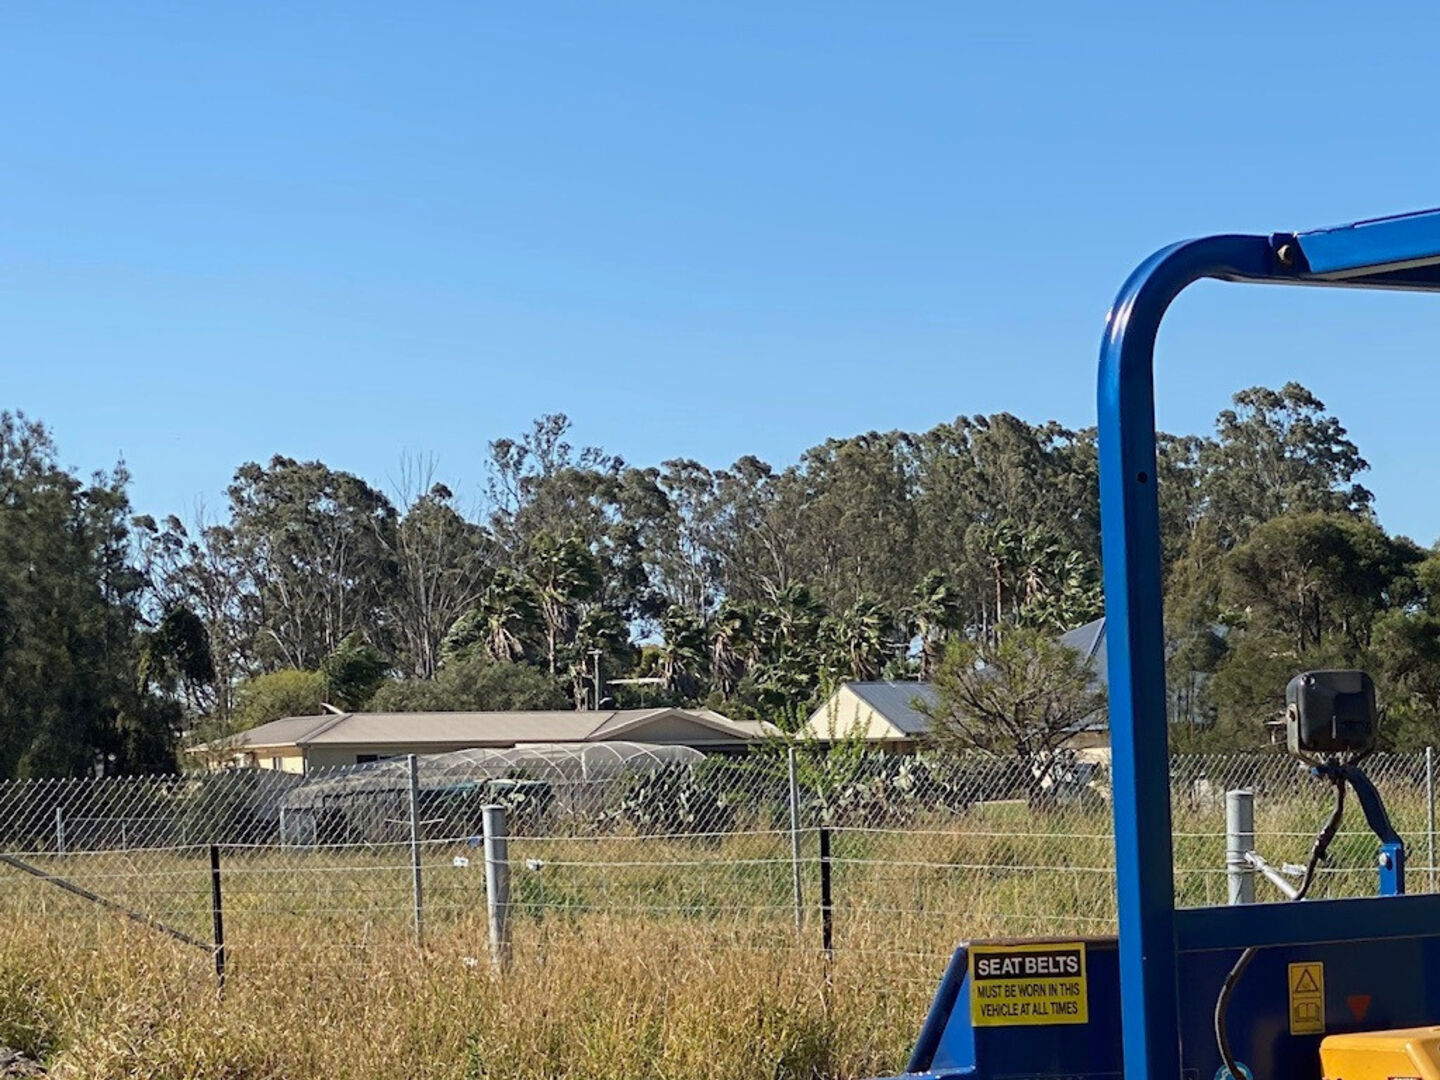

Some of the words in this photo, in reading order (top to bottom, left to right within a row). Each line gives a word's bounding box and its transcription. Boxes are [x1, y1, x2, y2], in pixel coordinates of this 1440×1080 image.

[978, 957, 1023, 976] SEAT
[1025, 955, 1079, 974] BELTS
[977, 984, 1002, 998] MUST
[1004, 984, 1017, 998] BE
[1017, 983, 1046, 997] WORN
[1048, 983, 1058, 996] IN
[1059, 982, 1080, 996] THIS
[980, 1003, 1019, 1017] VEHICLE
[1020, 1002, 1031, 1016] AT
[1031, 1002, 1049, 1015] ALL
[1050, 1001, 1078, 1015] TIMES
